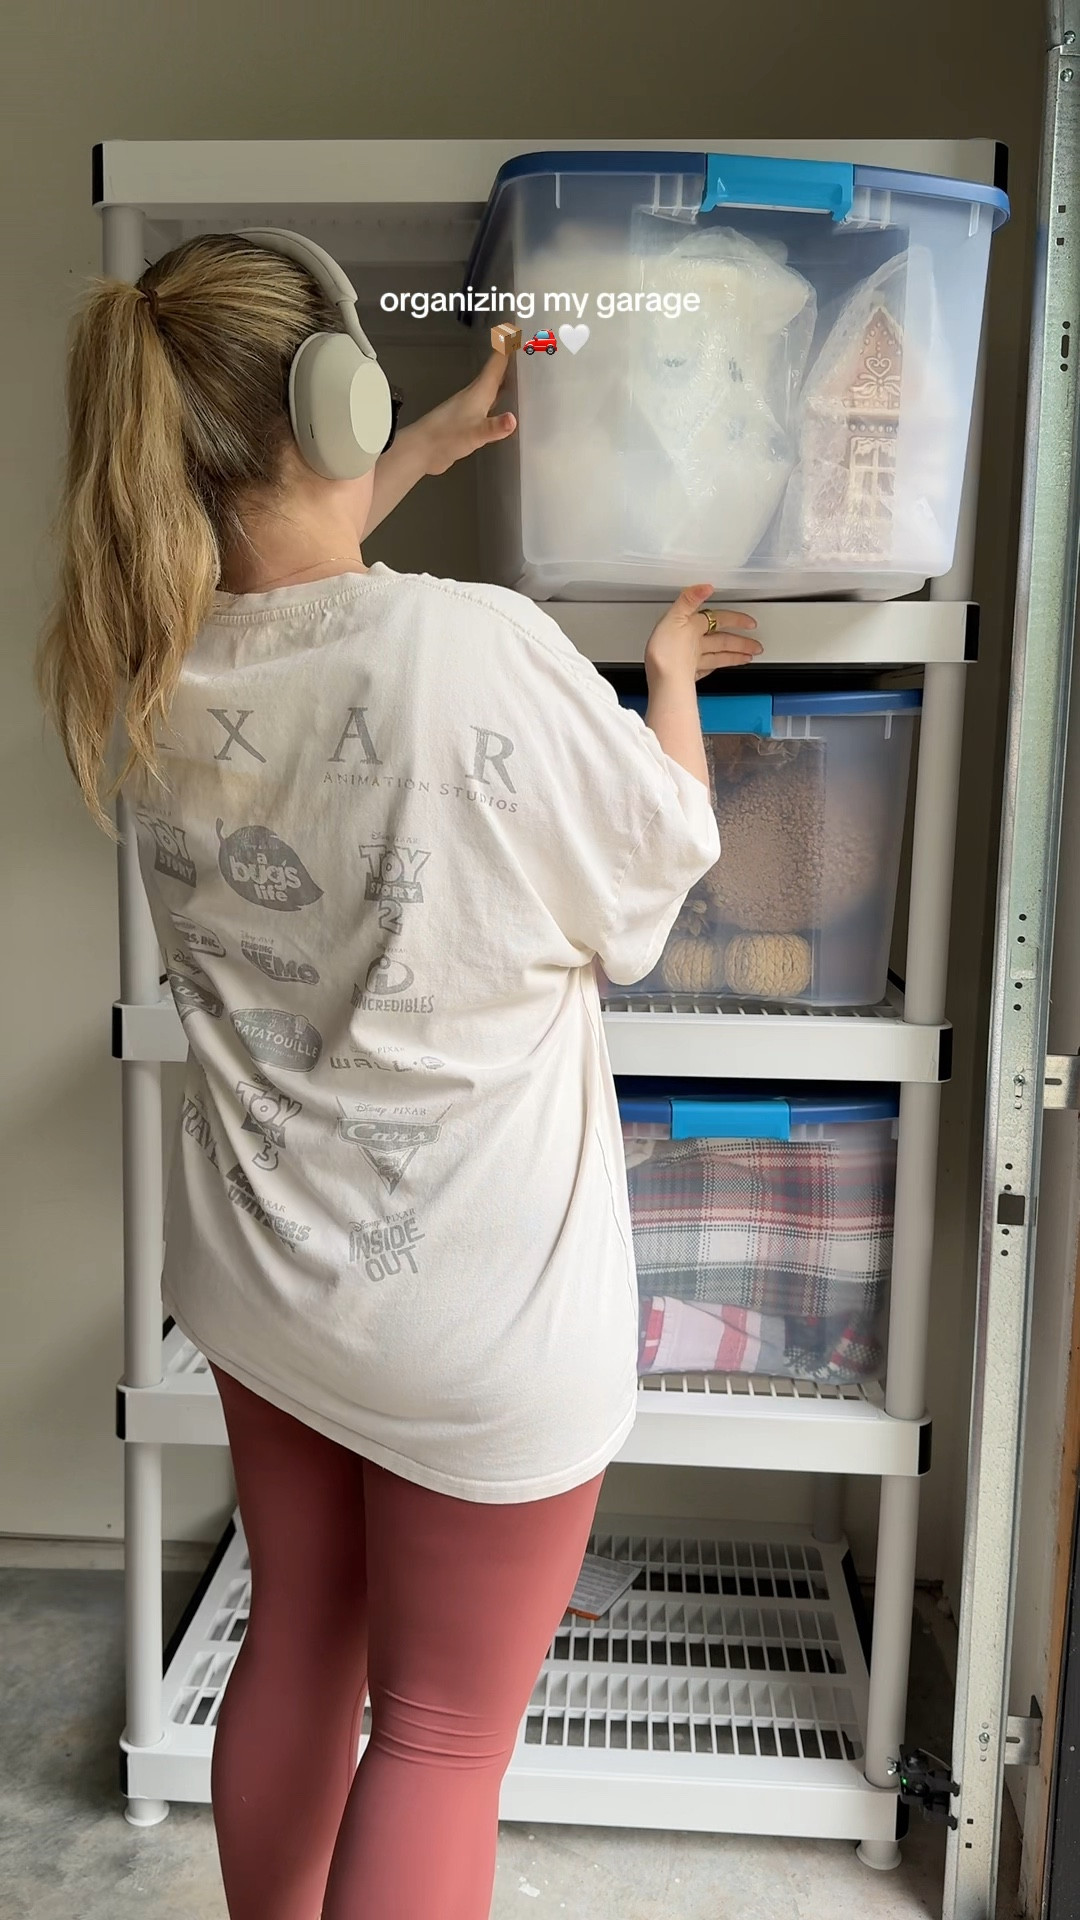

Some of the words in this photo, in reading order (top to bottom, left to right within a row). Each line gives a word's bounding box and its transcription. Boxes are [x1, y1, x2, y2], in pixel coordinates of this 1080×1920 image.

[156, 706, 517, 794] XAR
[323, 771, 430, 792] ANIMATION
[439, 783, 519, 814] STUDIOS
[229, 855, 301, 892] bug's
[257, 853, 268, 865] a
[359, 844, 431, 884] TOY
[254, 884, 288, 902] life
[370, 882, 418, 900] STORY
[378, 898, 404, 936] 2
[234, 1019, 320, 1059] RATATOUILLE
[236, 1080, 303, 1128] TOY
[346, 1123, 429, 1143] Cars
[349, 1217, 426, 1263] INSIDE
[365, 1243, 419, 1282] OUT
